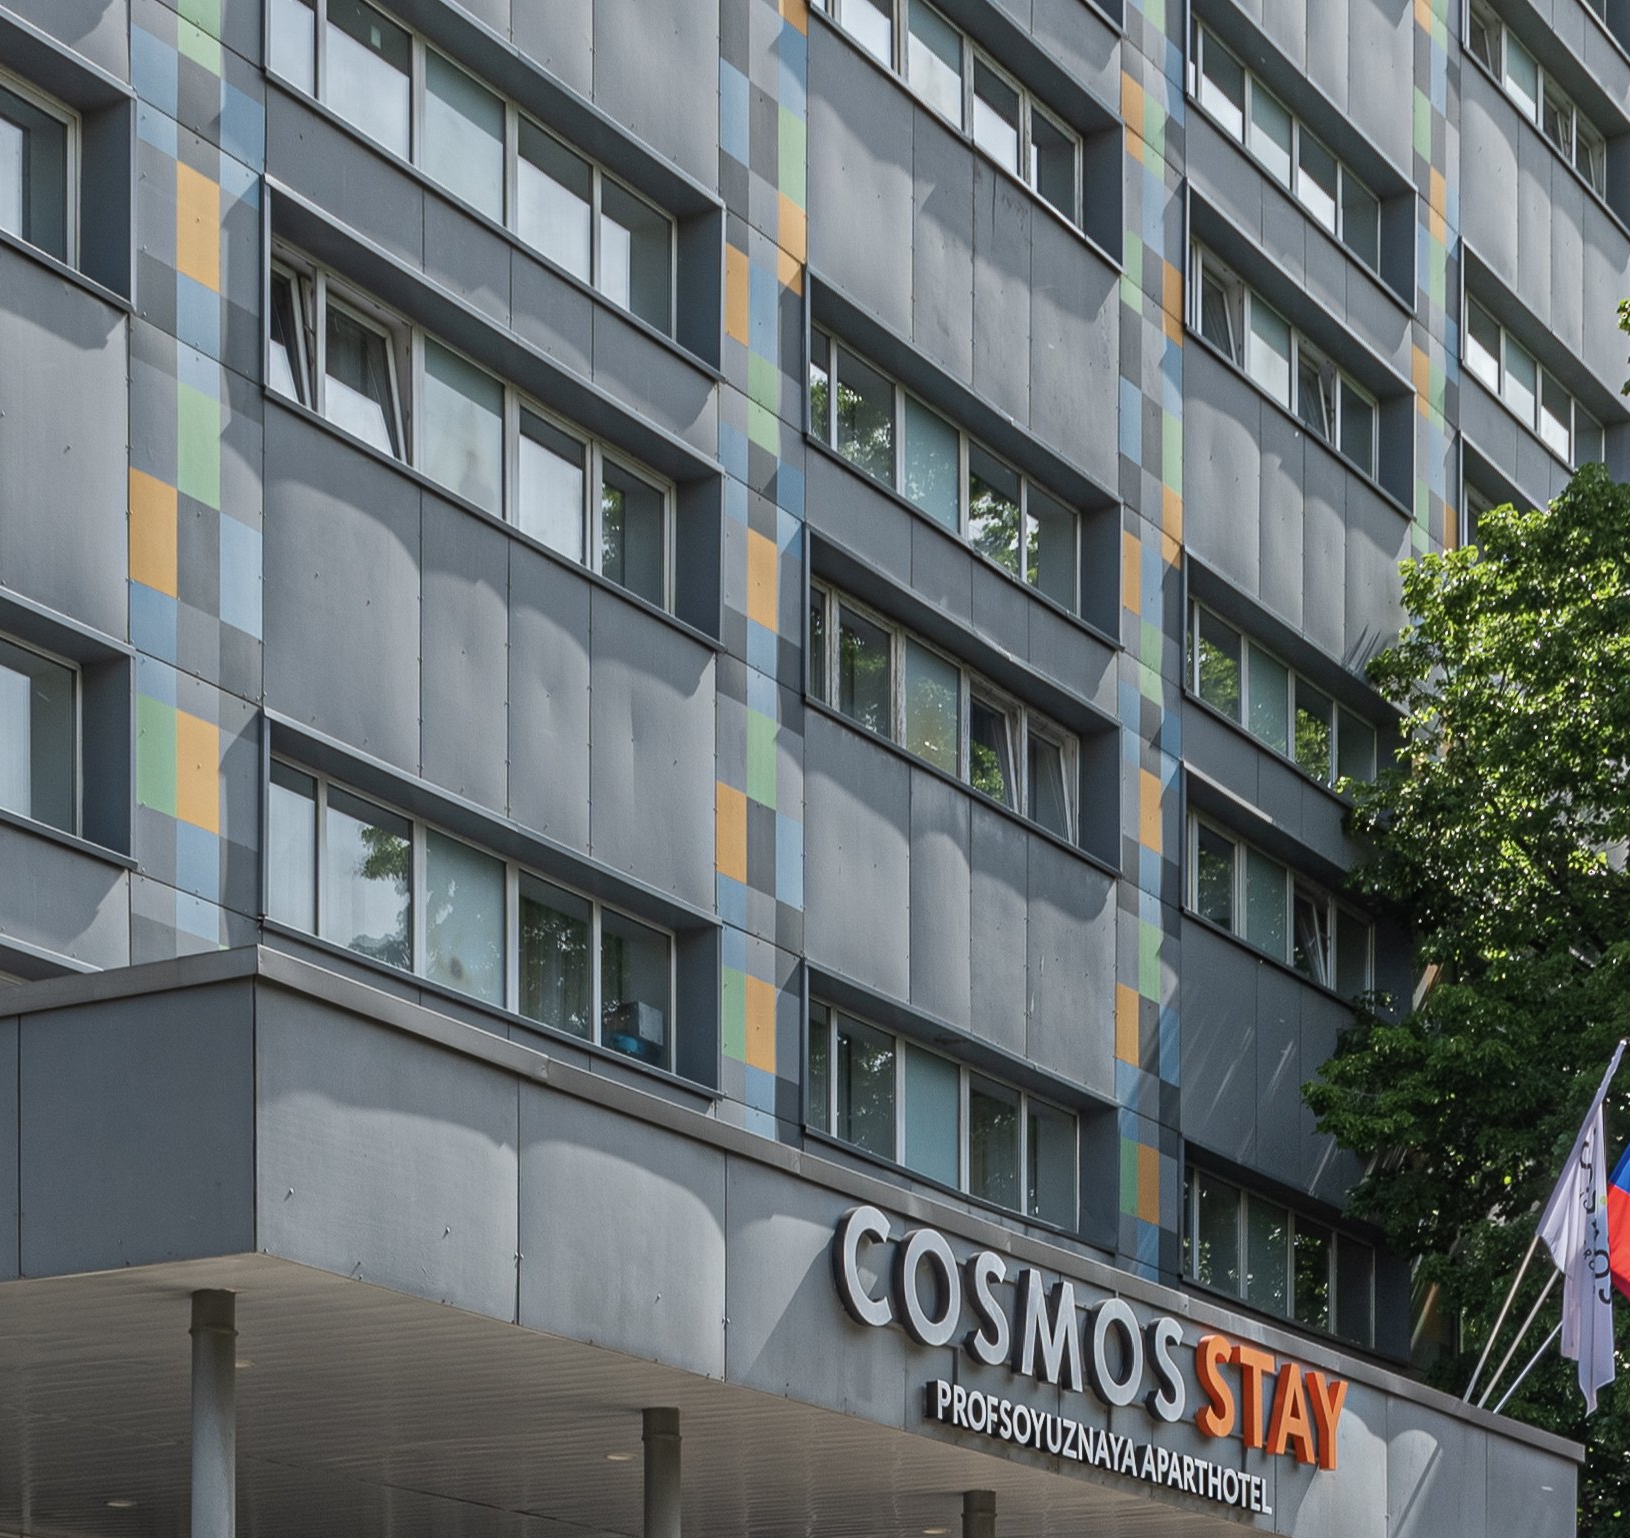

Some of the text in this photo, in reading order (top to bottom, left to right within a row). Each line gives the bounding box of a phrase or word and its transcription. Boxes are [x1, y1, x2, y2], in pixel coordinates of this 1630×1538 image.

[834, 1205, 1348, 1471] COSMOS STAY
[929, 1379, 1272, 1515] PROFSOYUZNAYA APARTHOTEL
